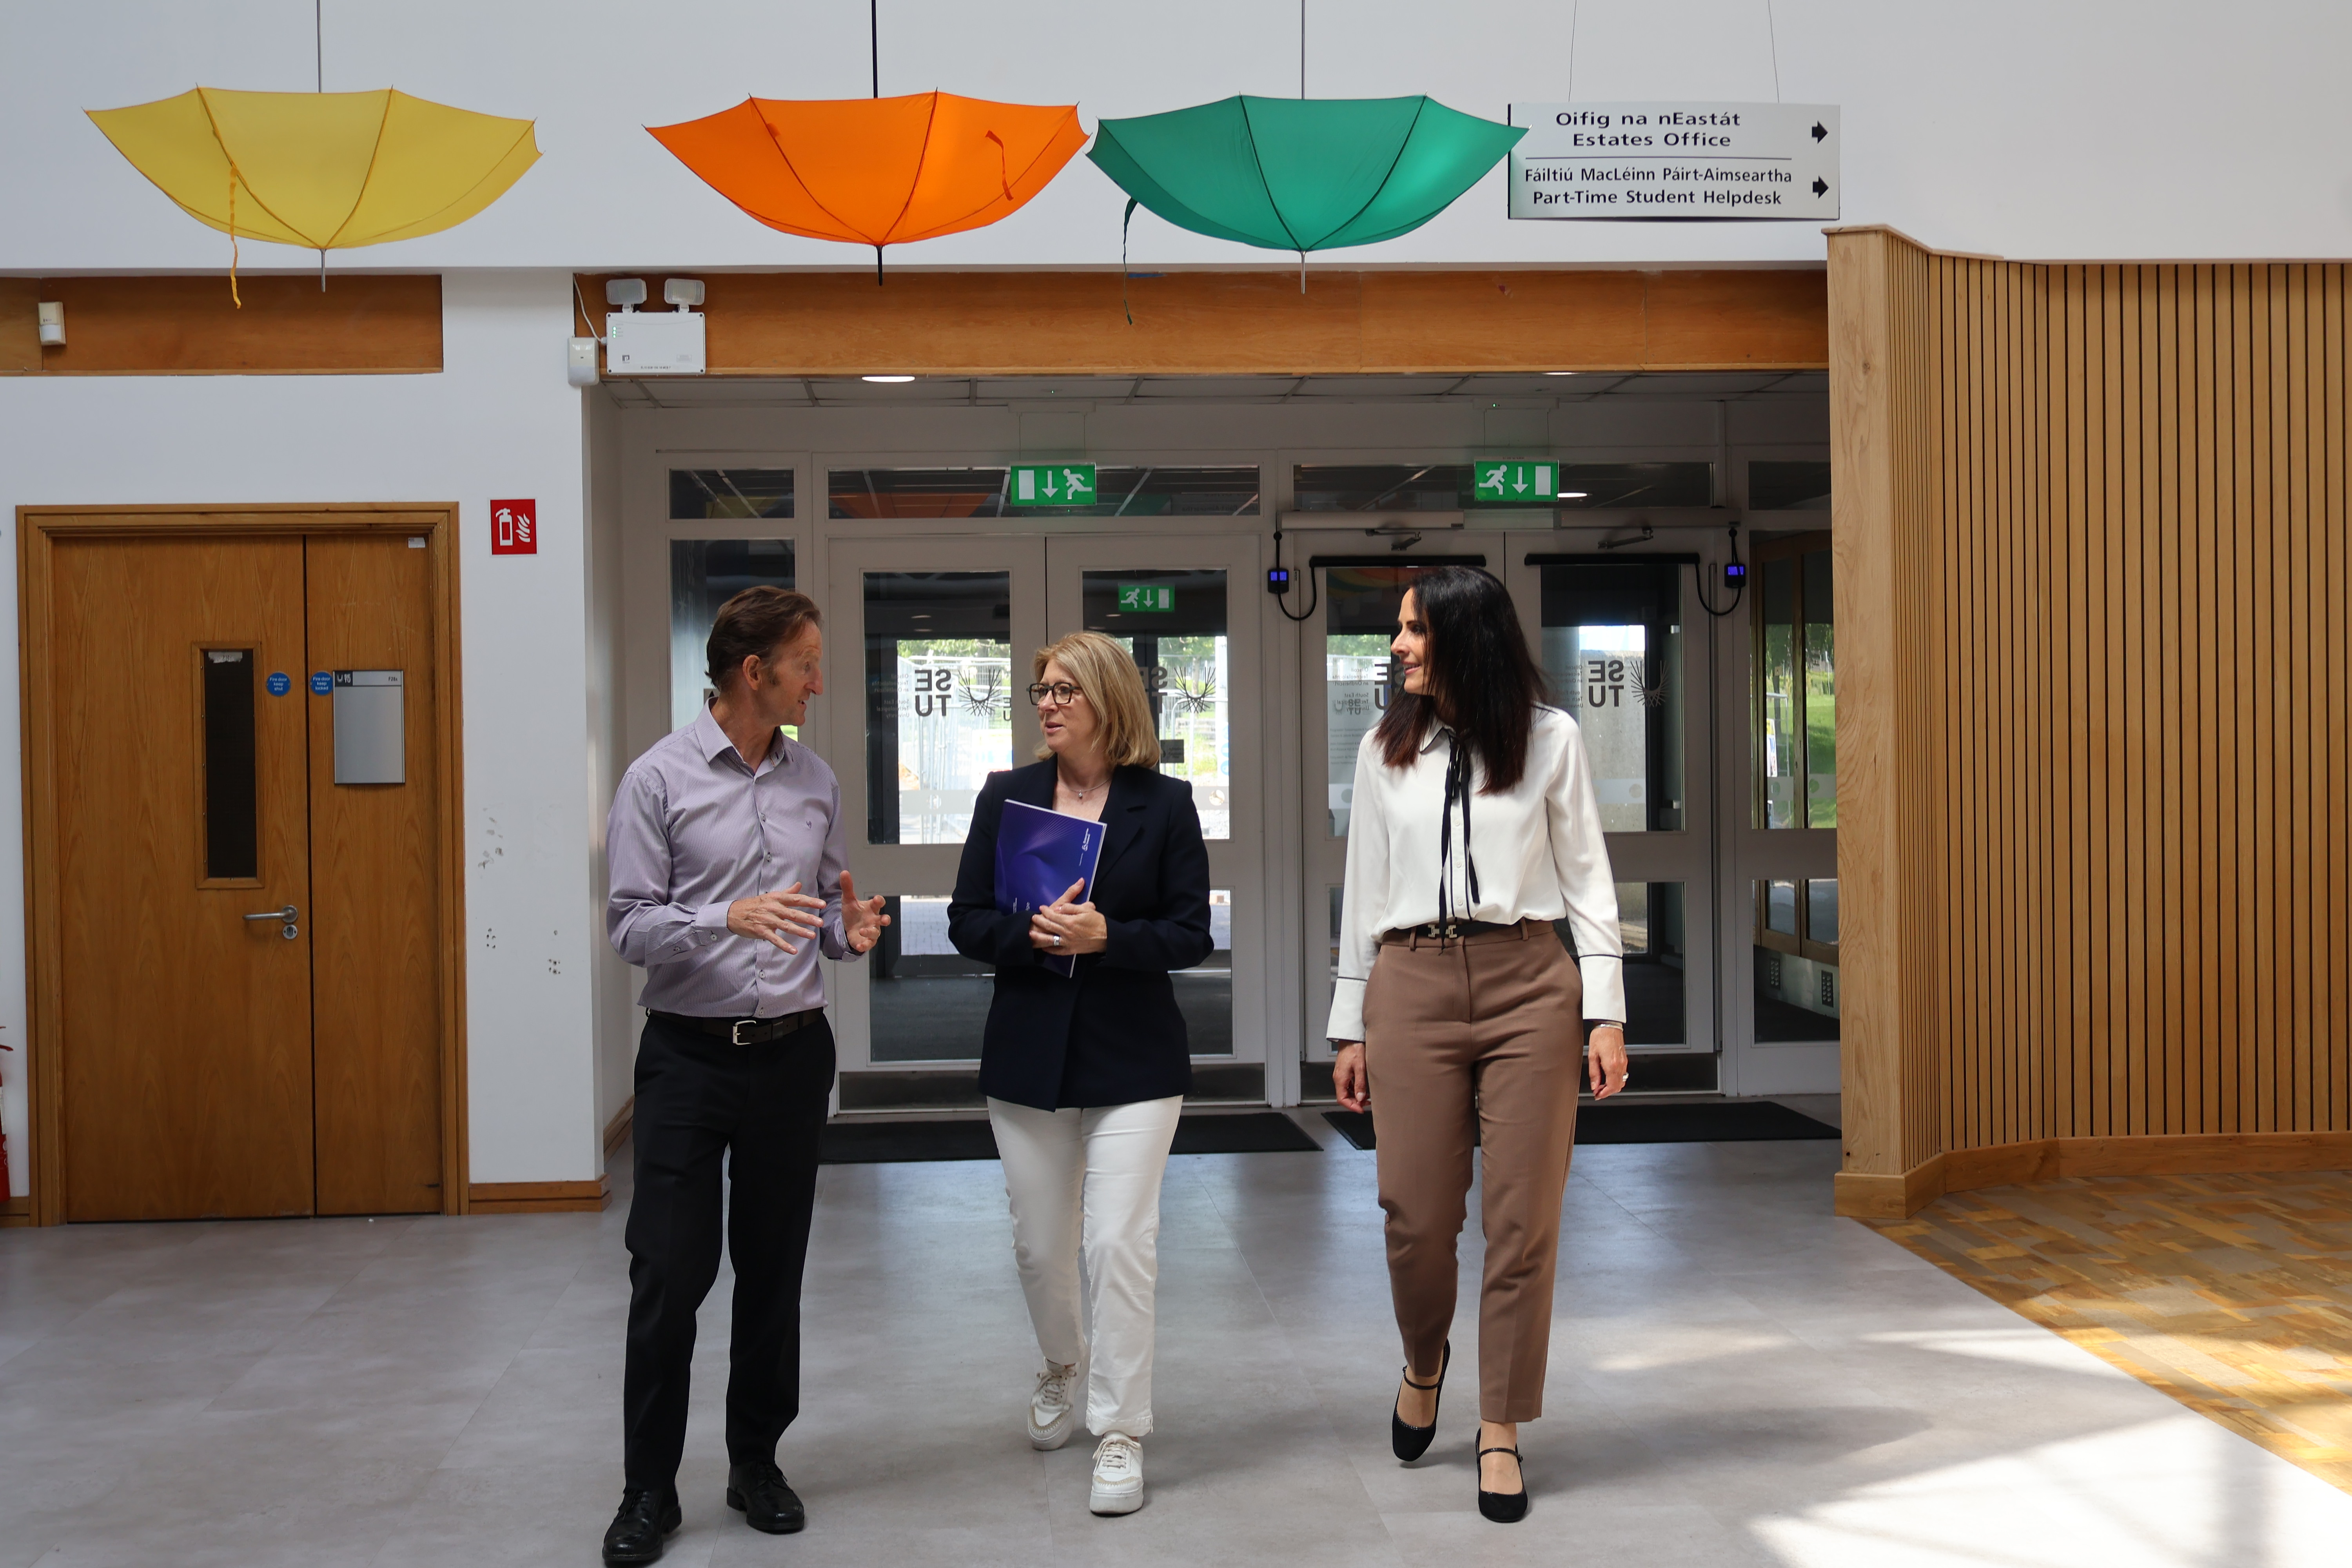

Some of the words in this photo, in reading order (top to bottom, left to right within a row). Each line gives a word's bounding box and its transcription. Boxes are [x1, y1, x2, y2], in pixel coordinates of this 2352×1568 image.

[1556, 112, 1610, 129] Oifig
[1621, 114, 1647, 126] na
[1659, 111, 1740, 127] nEastát
[1573, 133, 1653, 147] Estates
[1664, 132, 1731, 147] Office
[1525, 167, 1573, 183] Fáiltiú
[1581, 167, 1655, 182] MacLéinn
[1663, 167, 1792, 183] Páirt-Aimseartha
[1533, 190, 1618, 205] Part-Time
[1626, 190, 1695, 204] Student
[1704, 191, 1781, 207] Helpdesk
